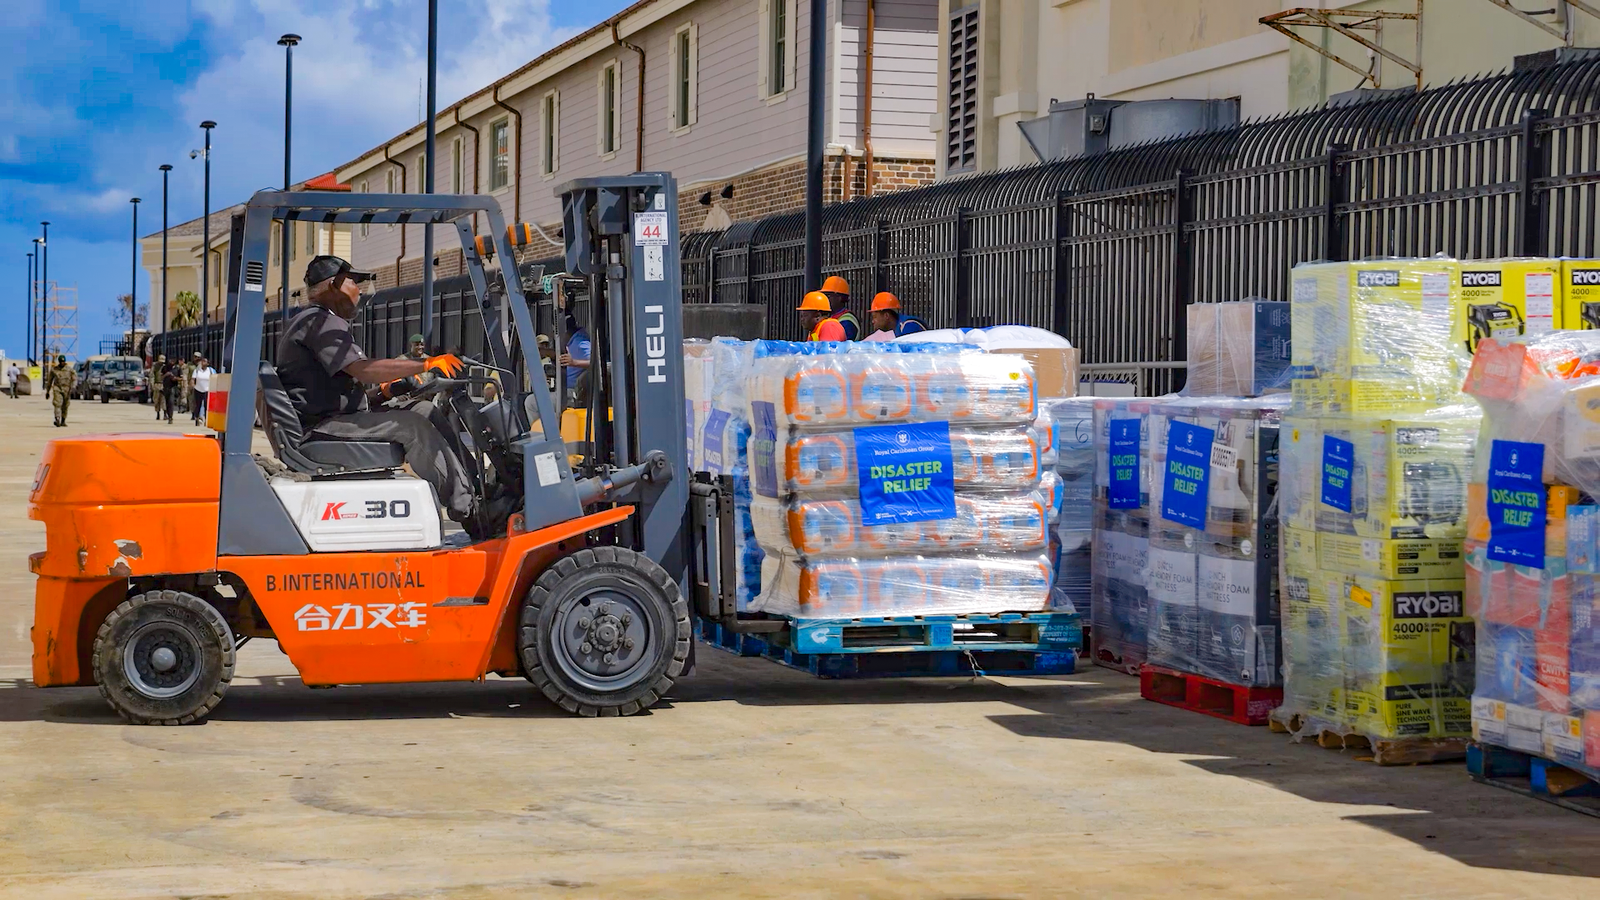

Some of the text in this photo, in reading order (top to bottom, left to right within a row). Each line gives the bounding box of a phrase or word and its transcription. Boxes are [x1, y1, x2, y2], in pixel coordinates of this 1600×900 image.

[642, 225, 661, 238] 44
[1359, 271, 1398, 285] RYOBI
[1462, 273, 1500, 285] RYOBI
[1572, 271, 1600, 284] RYO
[1461, 289, 1480, 297] 4000
[644, 305, 667, 383] HELI
[874, 449, 890, 457] Royal
[890, 447, 918, 455] Caribbean
[1112, 454, 1137, 466] DISASTER
[870, 460, 943, 479] DISASTER
[1116, 468, 1133, 481] RELIEF
[1170, 460, 1204, 481] DISASTER
[1325, 462, 1349, 479] DISASTER
[883, 477, 931, 494] RELIEF
[1173, 478, 1198, 496] RELIEF
[1328, 475, 1344, 489] RELIEF
[1491, 488, 1539, 508] DISASTER
[321, 501, 348, 520] K
[365, 500, 411, 519] 30
[1503, 508, 1533, 527] RELIEF
[266, 571, 425, 592] B.INTERNATIONAL
[1173, 573, 1192, 584] FOAM
[1226, 584, 1250, 595] FOAM
[1395, 595, 1460, 615] RYOBI
[294, 601, 427, 631] 合力叉车
[1393, 622, 1424, 633] 4000
[1541, 662, 1567, 677] CAVITY
